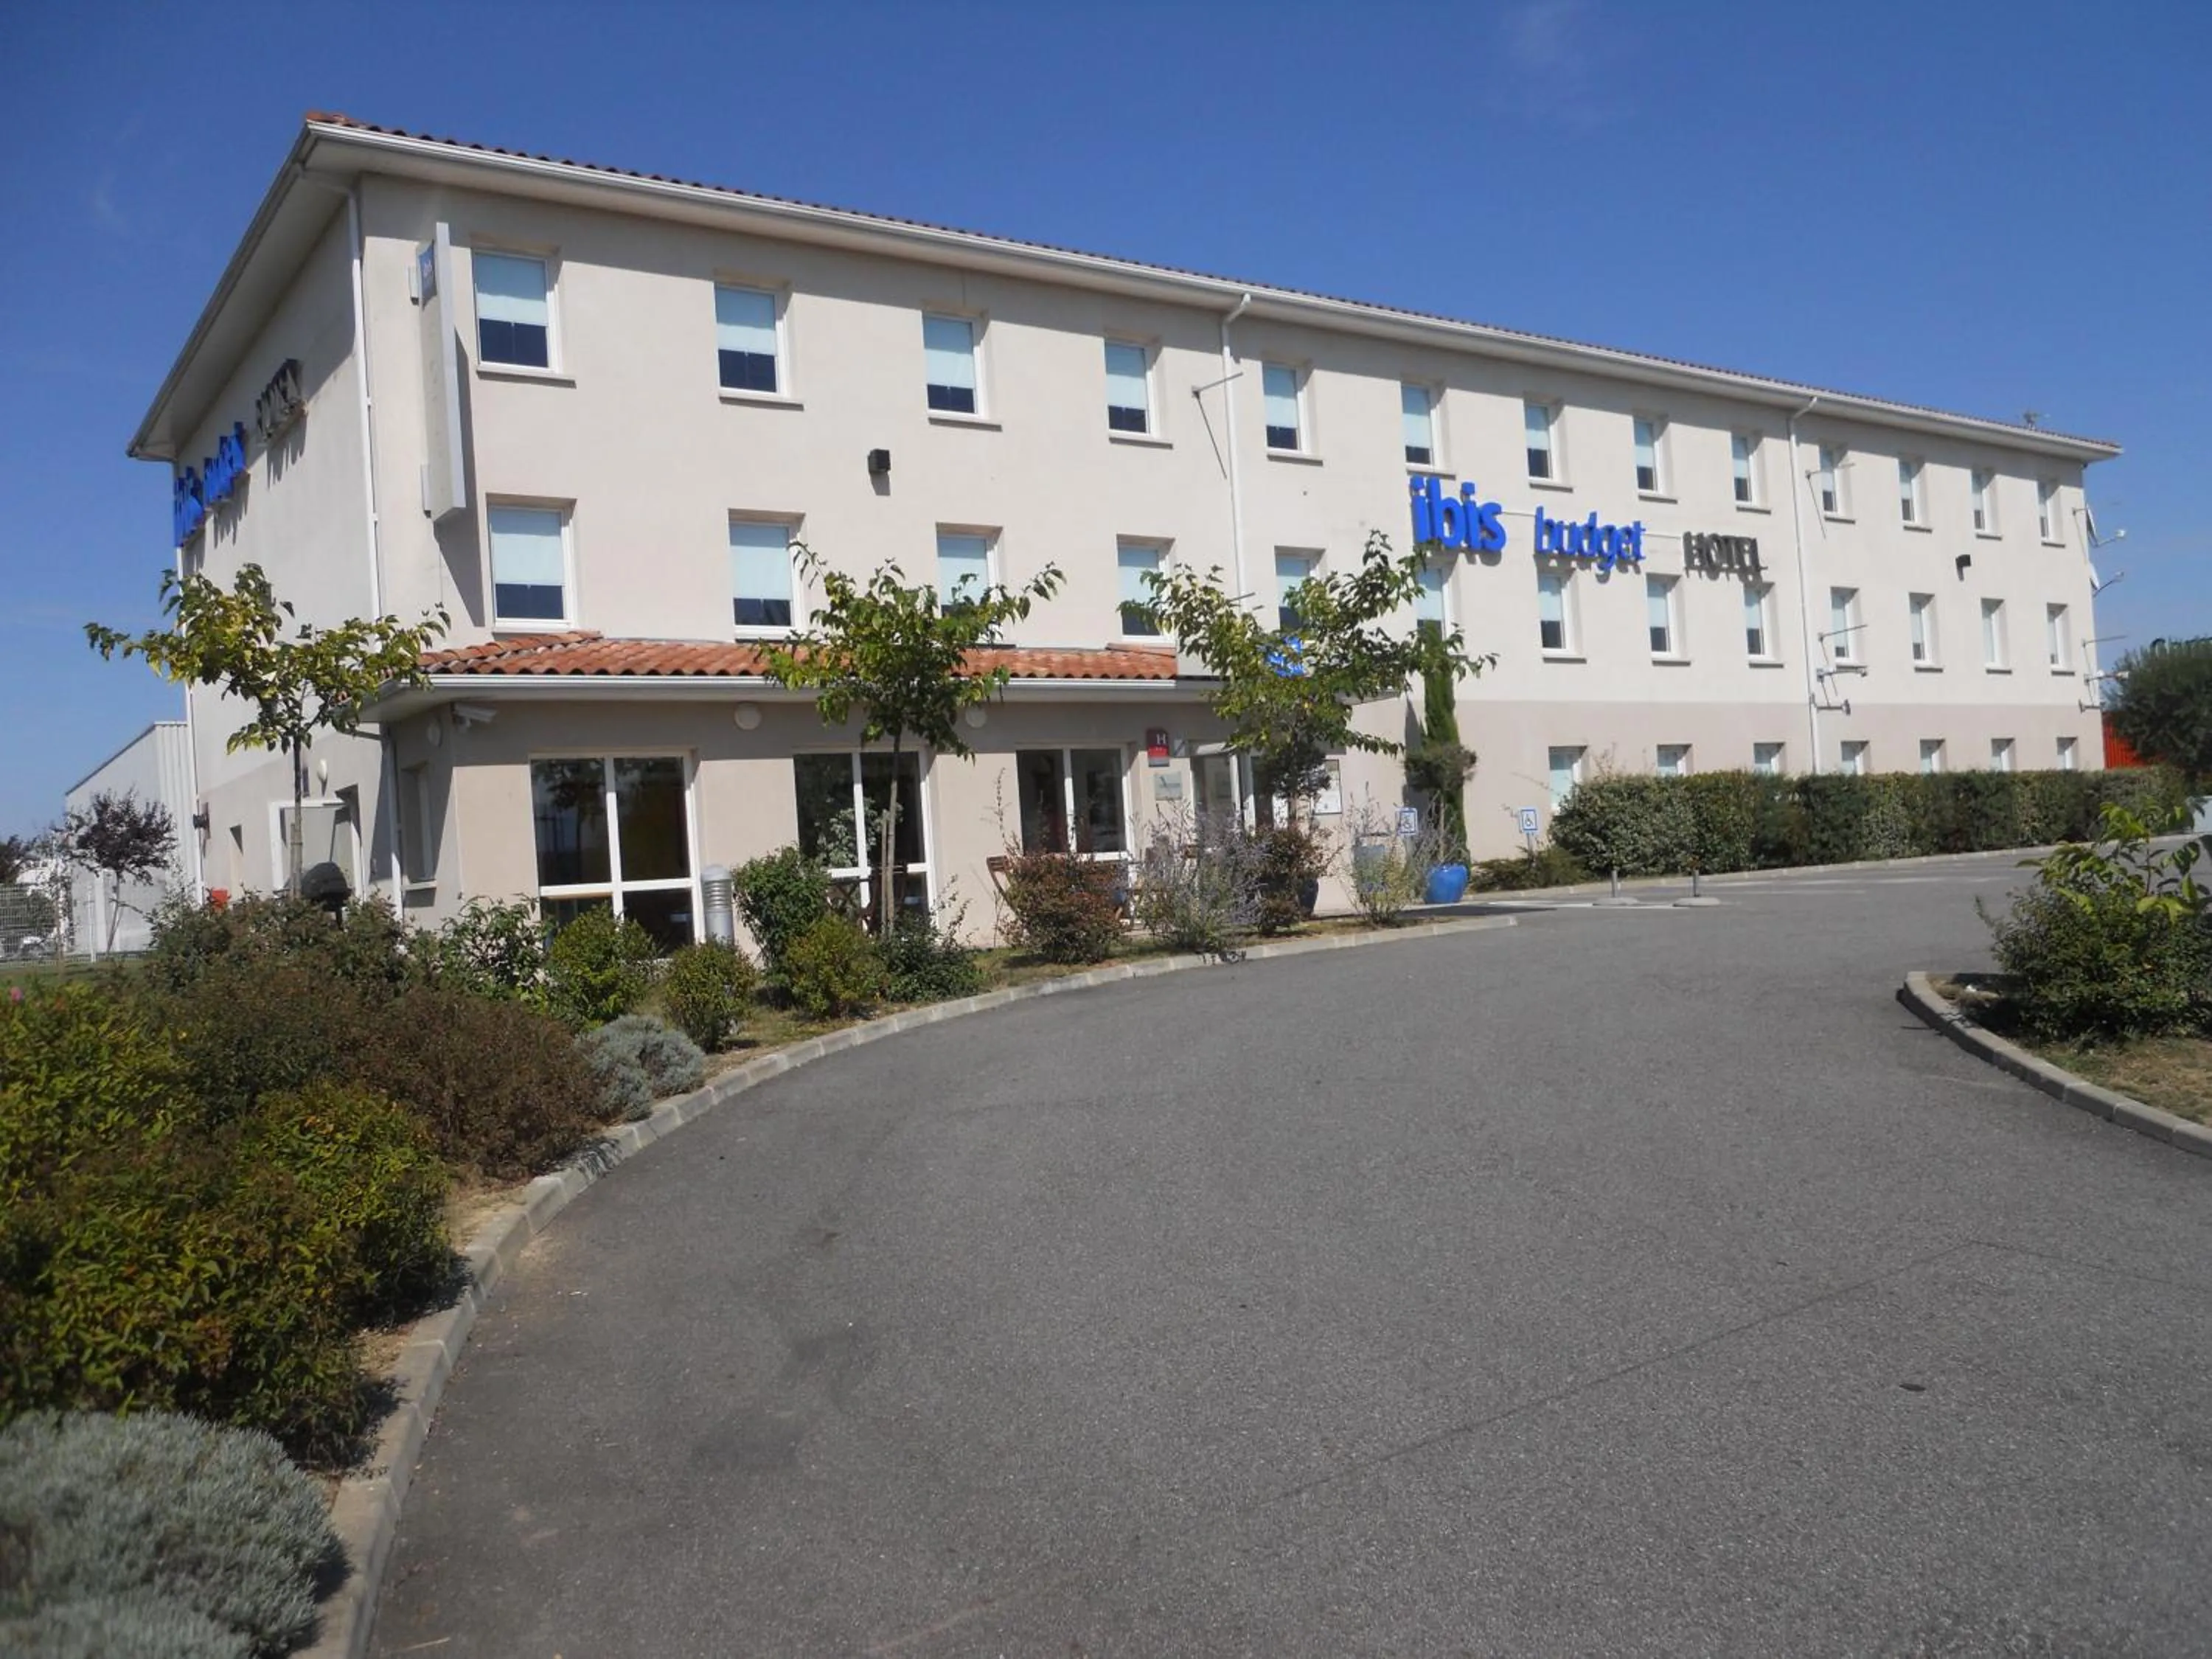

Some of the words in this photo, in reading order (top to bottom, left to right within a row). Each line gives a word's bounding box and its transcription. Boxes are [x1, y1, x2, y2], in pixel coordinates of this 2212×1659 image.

[1409, 473, 1506, 552] ibis
[1535, 506, 1646, 571] budget
[1683, 531, 1767, 571] HOTEL
[1155, 734, 1166, 745] H
